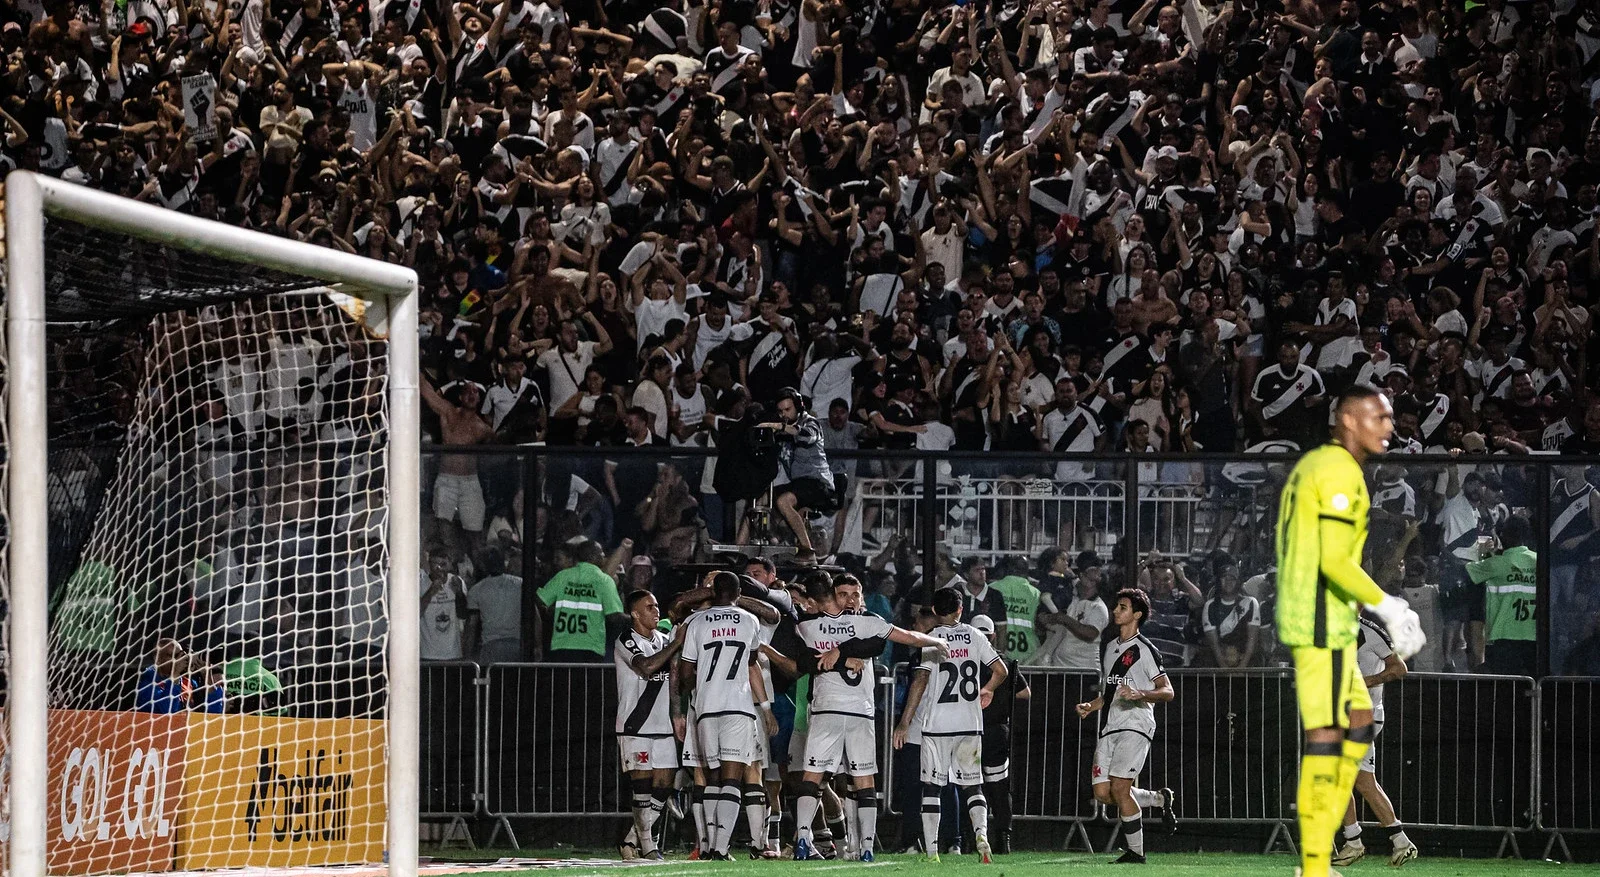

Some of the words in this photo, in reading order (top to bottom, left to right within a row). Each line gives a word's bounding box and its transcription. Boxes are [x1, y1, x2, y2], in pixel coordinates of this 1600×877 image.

[555, 611, 587, 634] 505
[714, 613, 741, 624] bmg
[712, 627, 737, 638] RAYAN
[828, 624, 856, 637] bmg
[946, 633, 972, 645] bmg
[1006, 631, 1028, 653] 68
[703, 640, 746, 683] 77
[937, 660, 979, 704] 28
[61, 747, 110, 842] GOL
[124, 747, 169, 840] GOL
[271, 747, 353, 843] betfair
